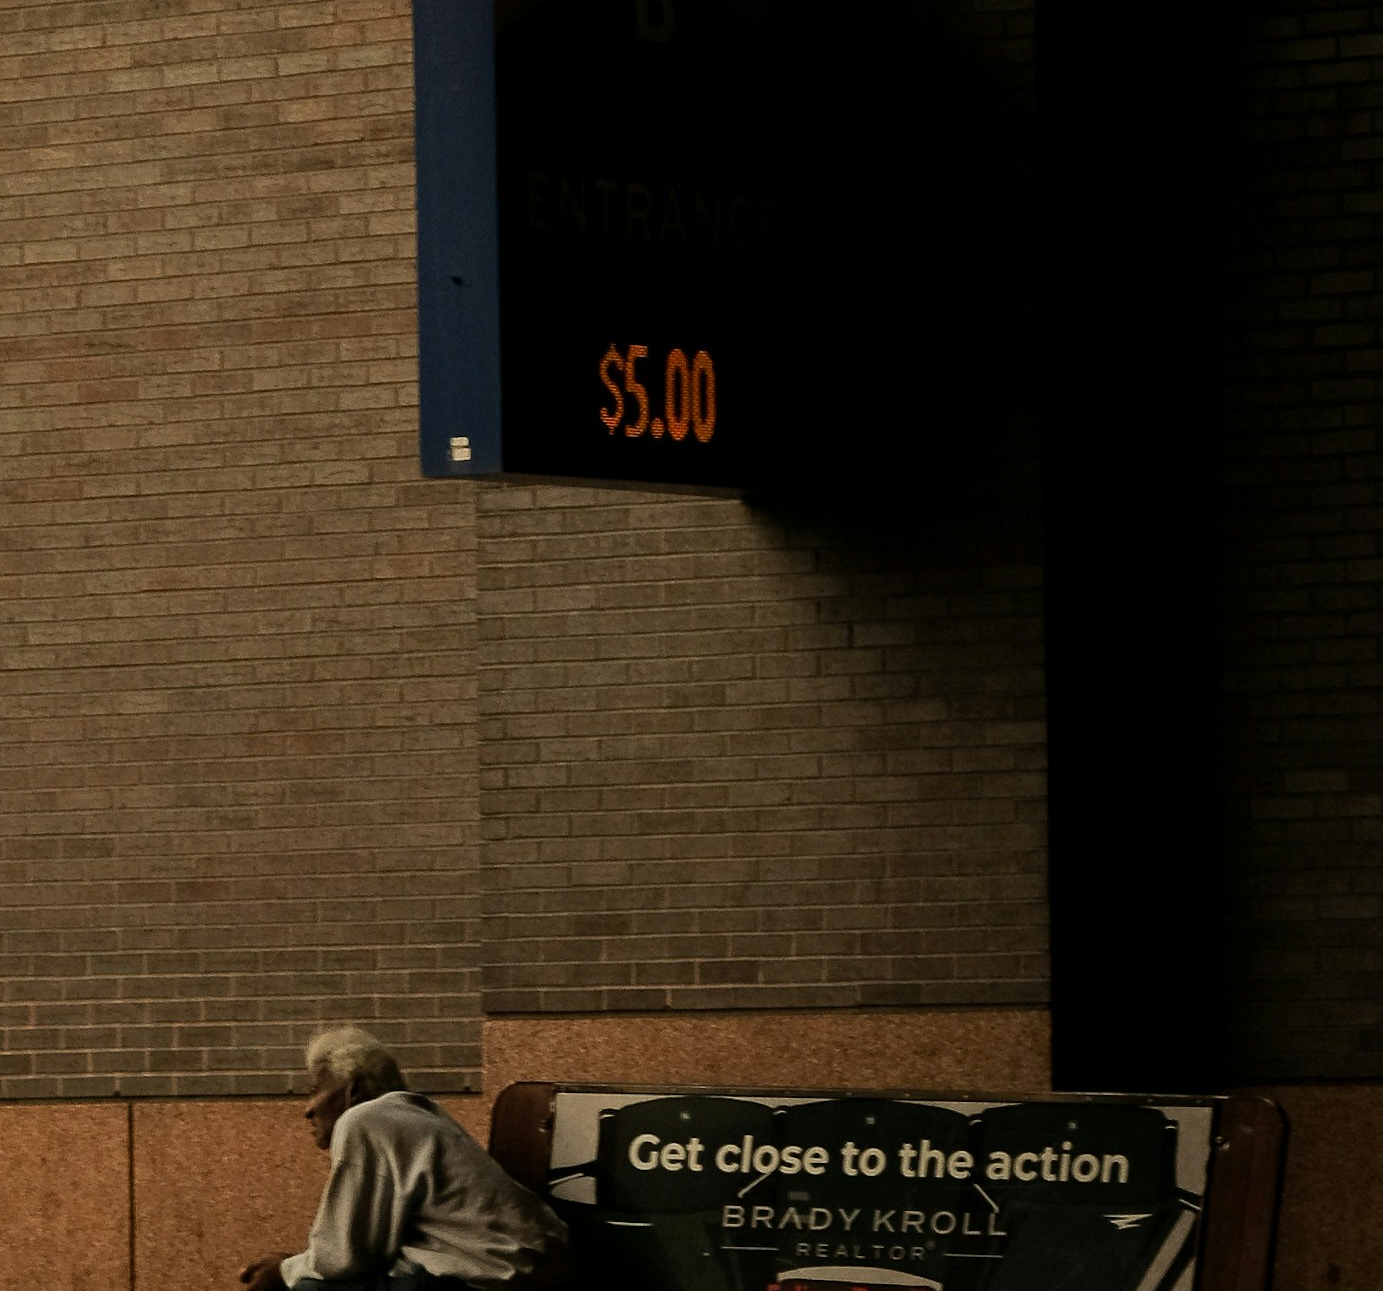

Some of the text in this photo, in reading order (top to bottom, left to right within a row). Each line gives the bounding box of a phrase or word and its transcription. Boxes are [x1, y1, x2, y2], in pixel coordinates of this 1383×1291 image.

[598, 341, 717, 443] $5.00
[628, 1133, 1130, 1184] Get close to the action
[721, 1205, 1008, 1236] BRADY KROLL
